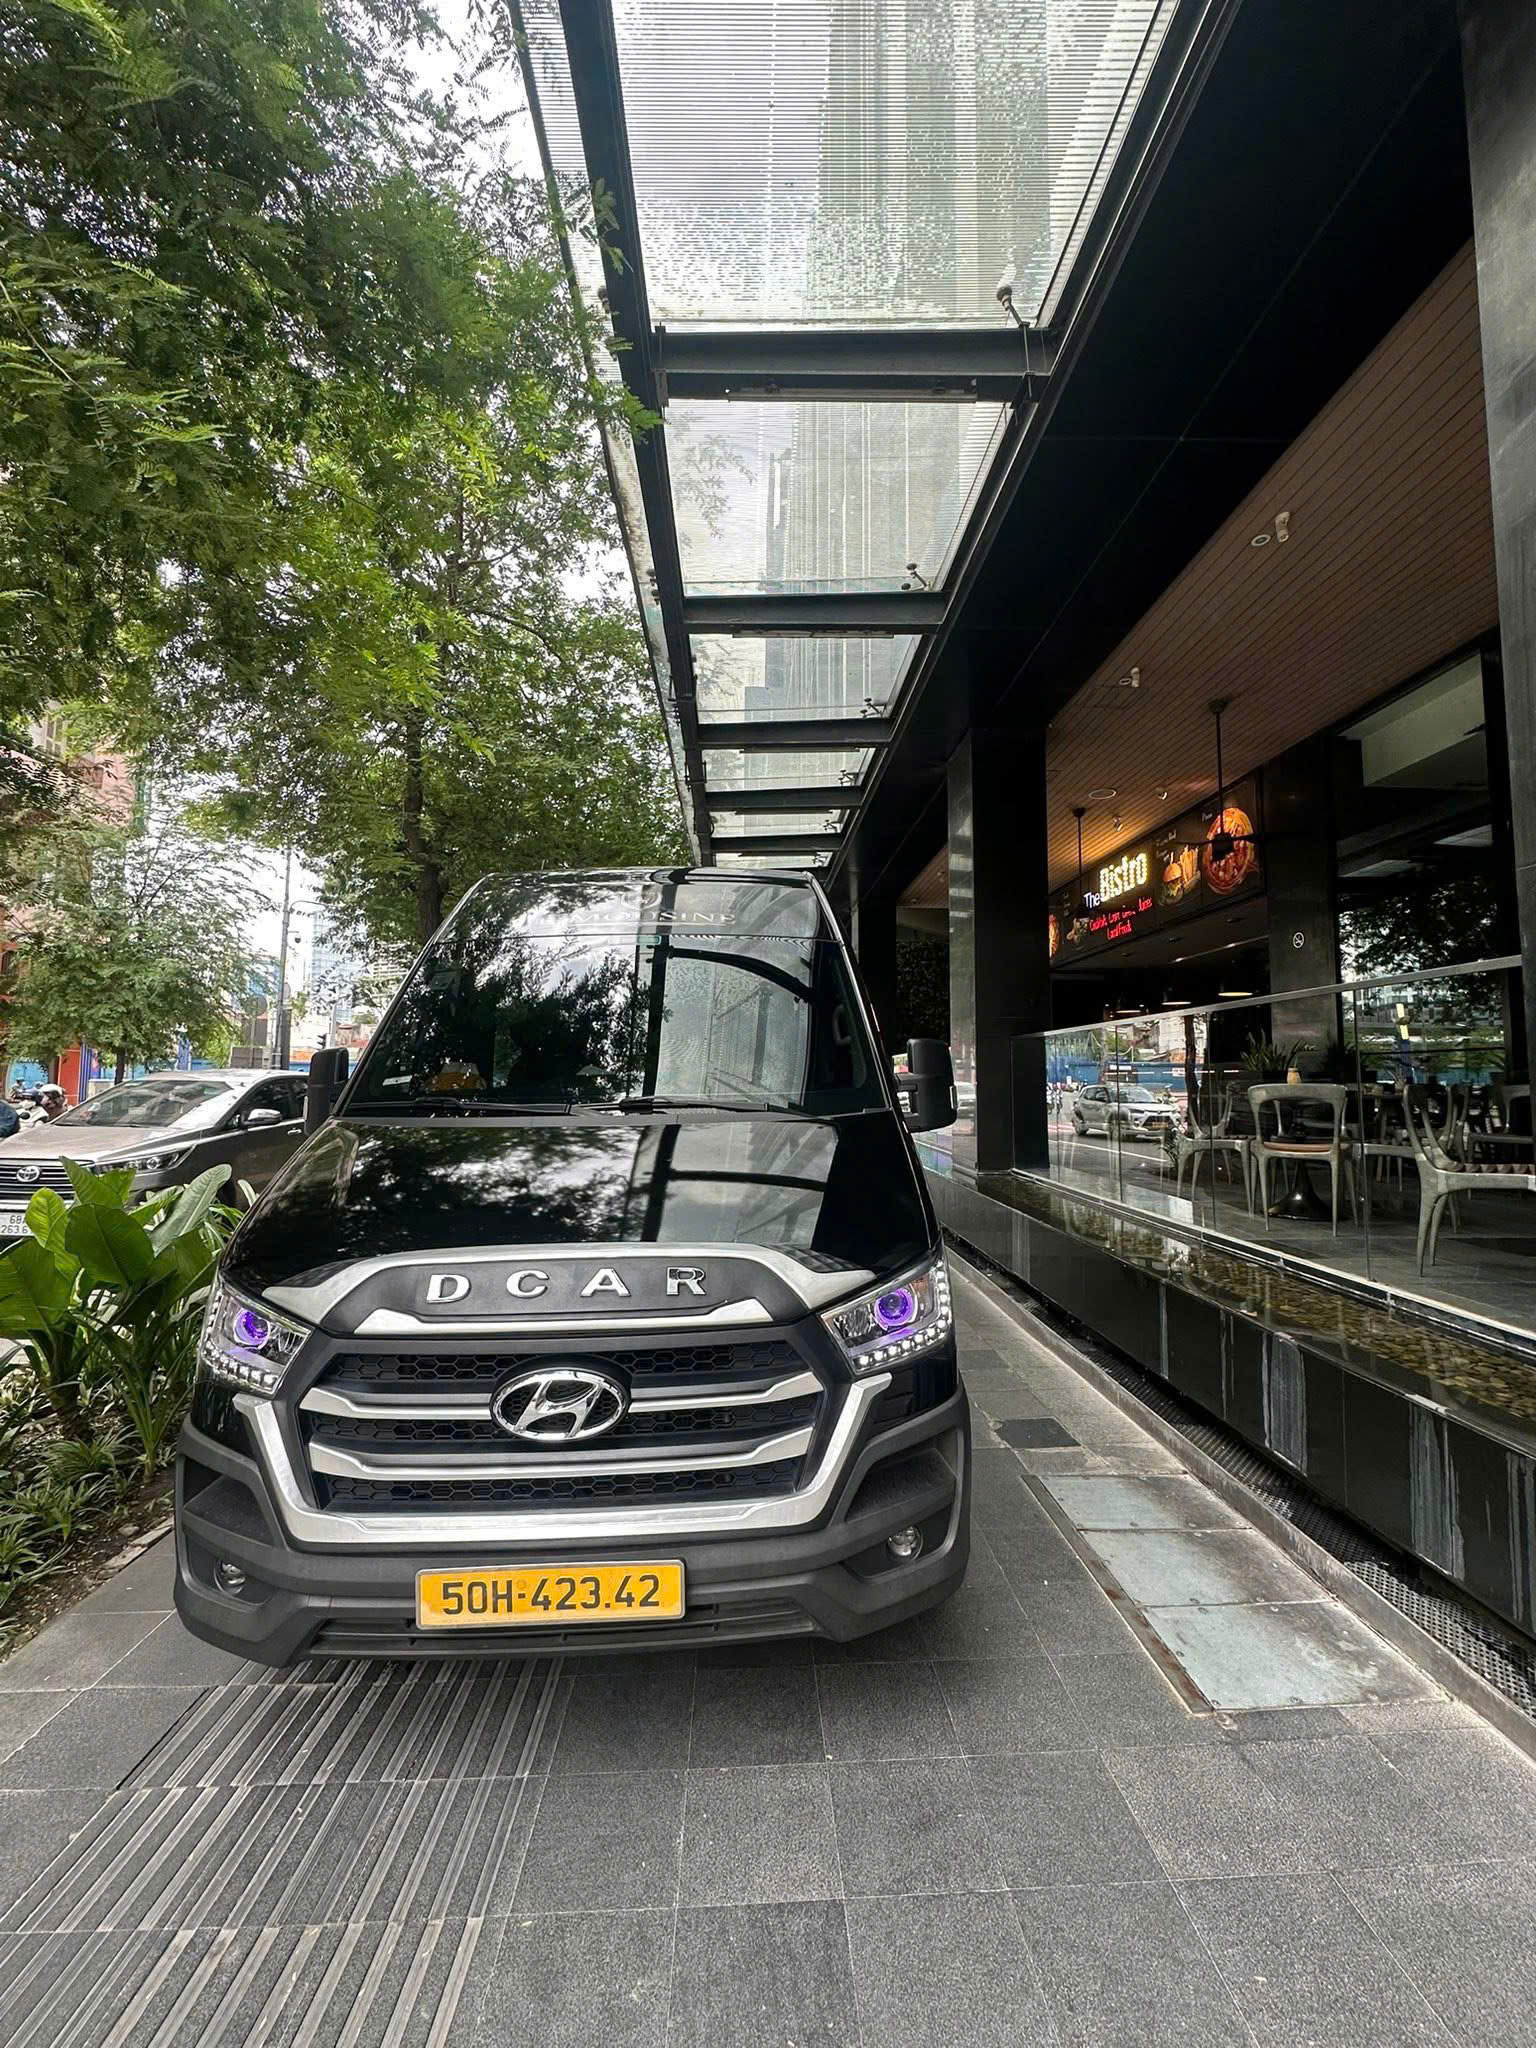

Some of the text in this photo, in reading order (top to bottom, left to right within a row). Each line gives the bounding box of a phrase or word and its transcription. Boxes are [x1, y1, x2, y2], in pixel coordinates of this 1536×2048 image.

[1084, 892, 1100, 908] The
[1100, 853, 1147, 902] Bistro
[10, 1215, 25, 1224] 68
[442, 1574, 660, 1616] 50H-423.42
